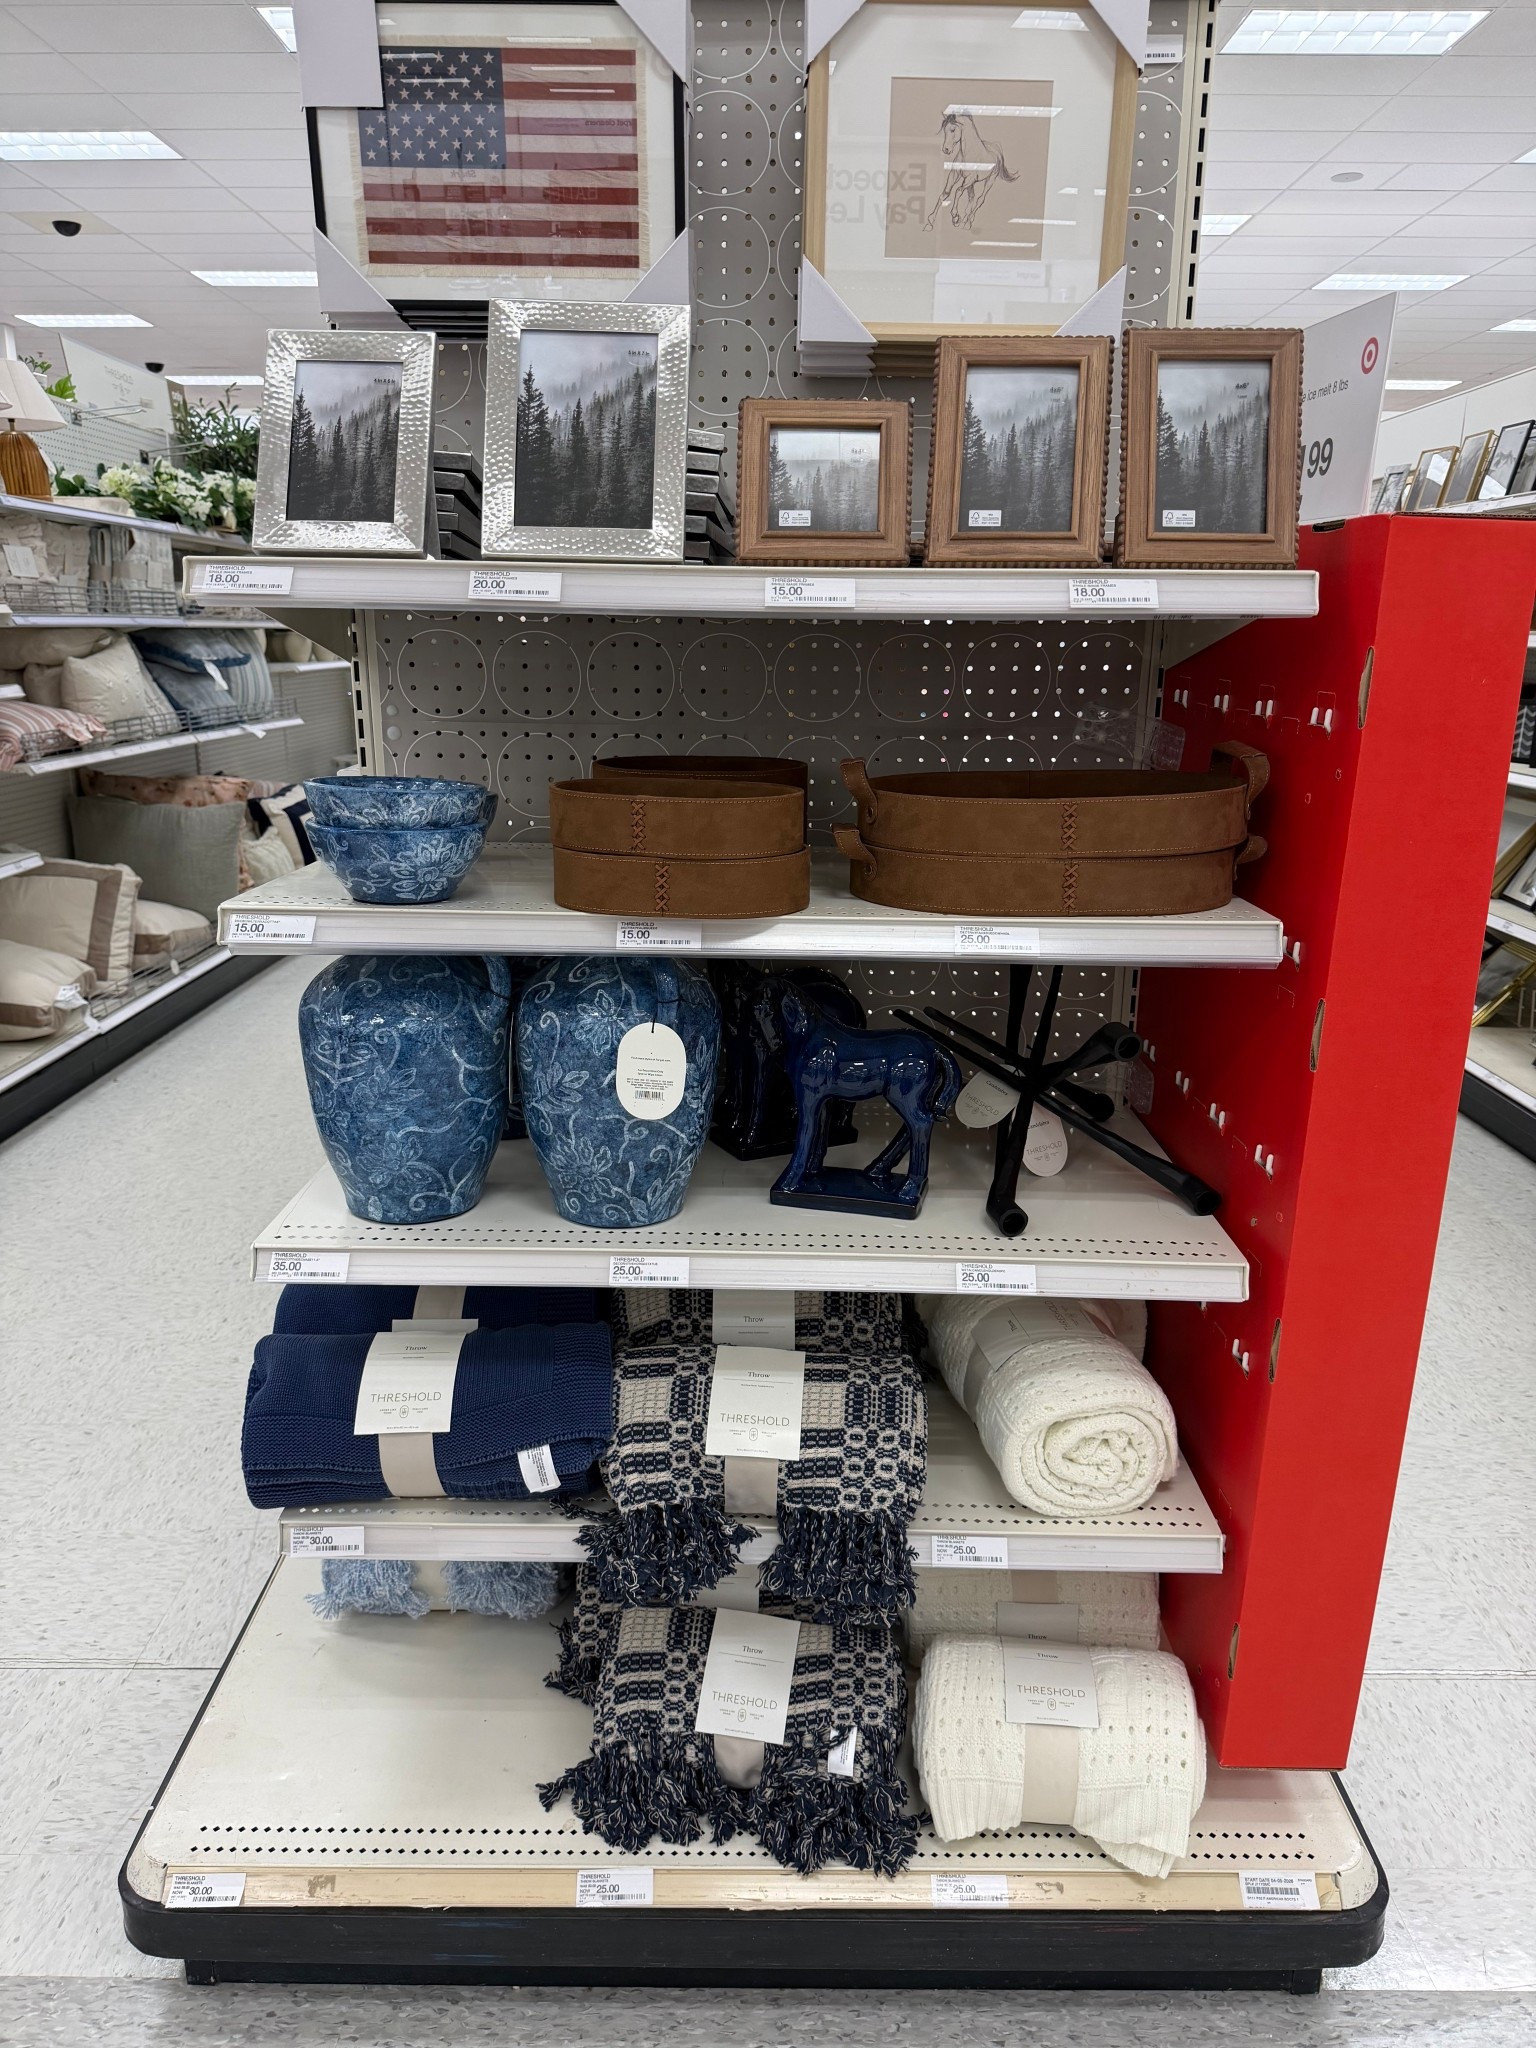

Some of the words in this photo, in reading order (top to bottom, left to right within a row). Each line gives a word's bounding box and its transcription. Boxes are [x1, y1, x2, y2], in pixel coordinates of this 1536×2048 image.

[1306, 389, 1317, 401] ice
[1318, 383, 1332, 398] melt
[1332, 381, 1338, 394] 8
[1340, 379, 1349, 391] lbs
[209, 574, 239, 583] 18.00
[473, 580, 506, 589] 20.00
[772, 586, 803, 596] 15.00
[1074, 588, 1105, 597] 18.00
[234, 923, 264, 932] 15.00
[621, 930, 650, 939] 15.00
[960, 934, 990, 944] 25.00
[965, 1092, 999, 1116] THRESHOLD
[1026, 1140, 1063, 1155] THRESHOLD
[272, 1262, 301, 1271] 35.00
[613, 1266, 641, 1275] 25.00
[962, 1273, 990, 1282] 25.00
[371, 1391, 442, 1403] THRESHOLD
[720, 1412, 790, 1427] THRESHOLD
[310, 1536, 333, 1545] 30.00
[953, 1546, 976, 1554] 25.00
[742, 1645, 764, 1654] Throw
[1016, 1684, 1086, 1698] THRESHOLD
[712, 1690, 778, 1710] THRESHOLD
[188, 1886, 213, 1895] 30.00
[596, 1884, 620, 1893] 25.00
[953, 1884, 976, 1893] 25.00
